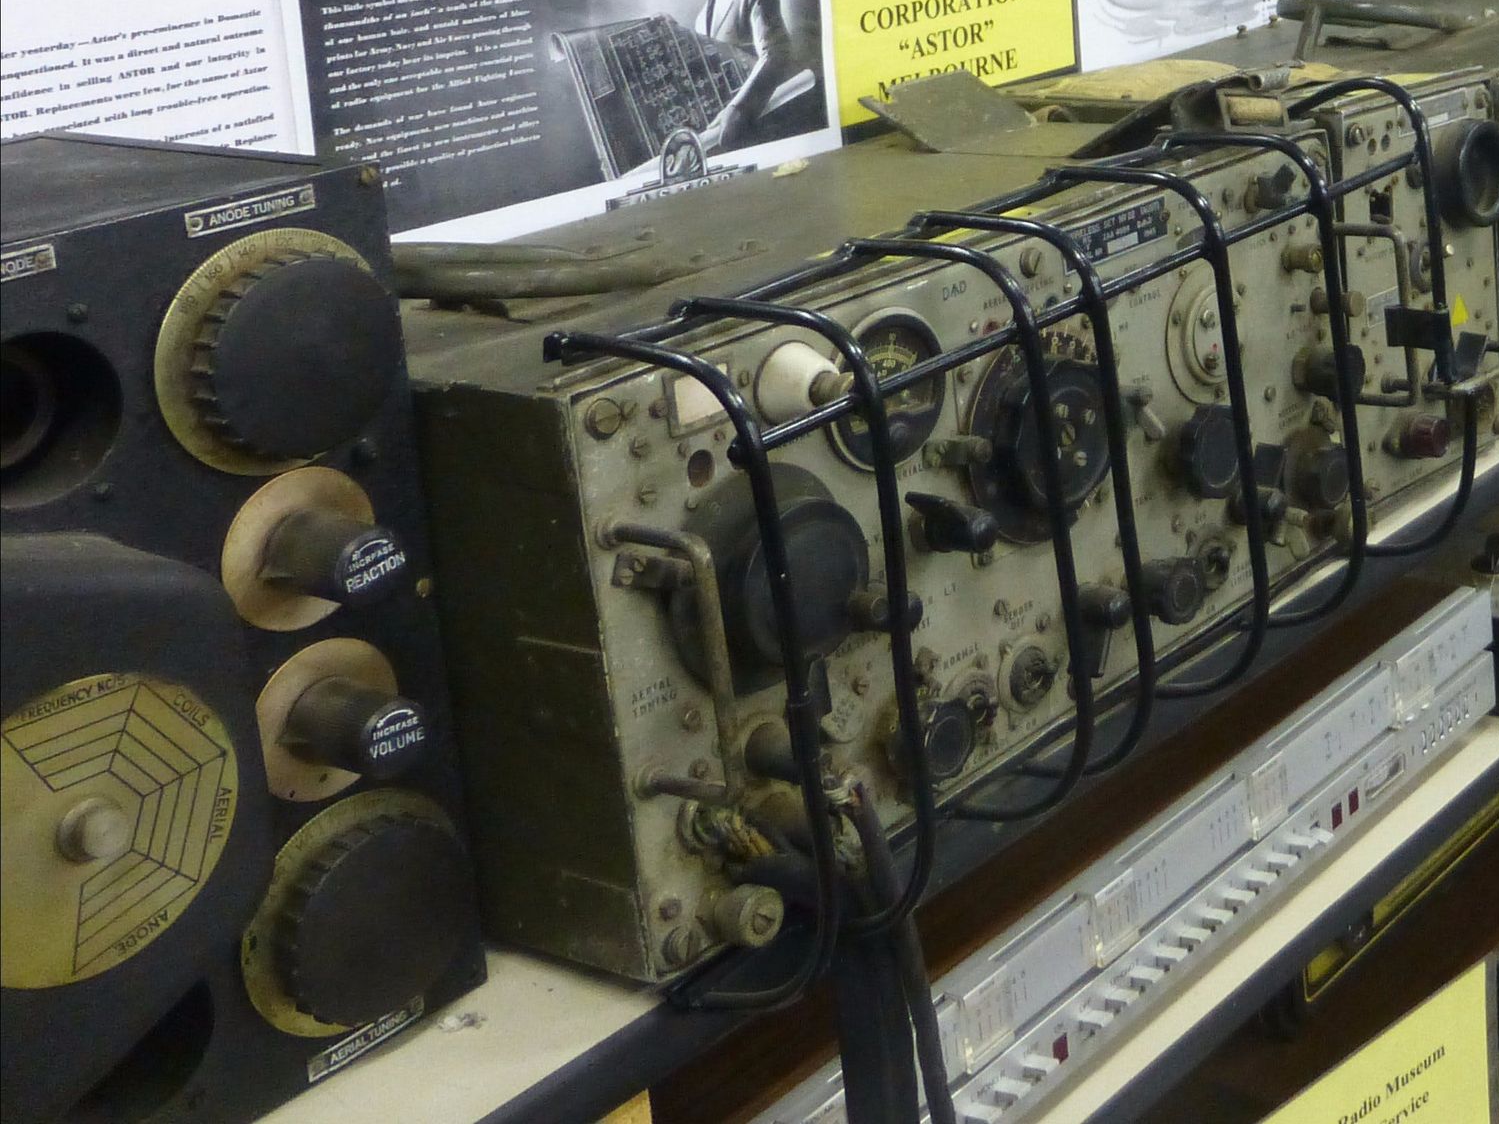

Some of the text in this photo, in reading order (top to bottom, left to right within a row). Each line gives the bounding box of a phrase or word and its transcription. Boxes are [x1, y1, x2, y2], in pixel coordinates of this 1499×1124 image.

[118, 66, 156, 81] ASTOR
[209, 194, 296, 228] ANODE TUNING
[0, 256, 33, 275] NODE
[346, 551, 406, 594] REACTION
[172, 692, 210, 727] COILS
[369, 727, 426, 759] VOLUME
[209, 786, 232, 844] AERIAL
[330, 1035, 368, 1065] AERIAL
[1385, 1044, 1446, 1099] Museum
